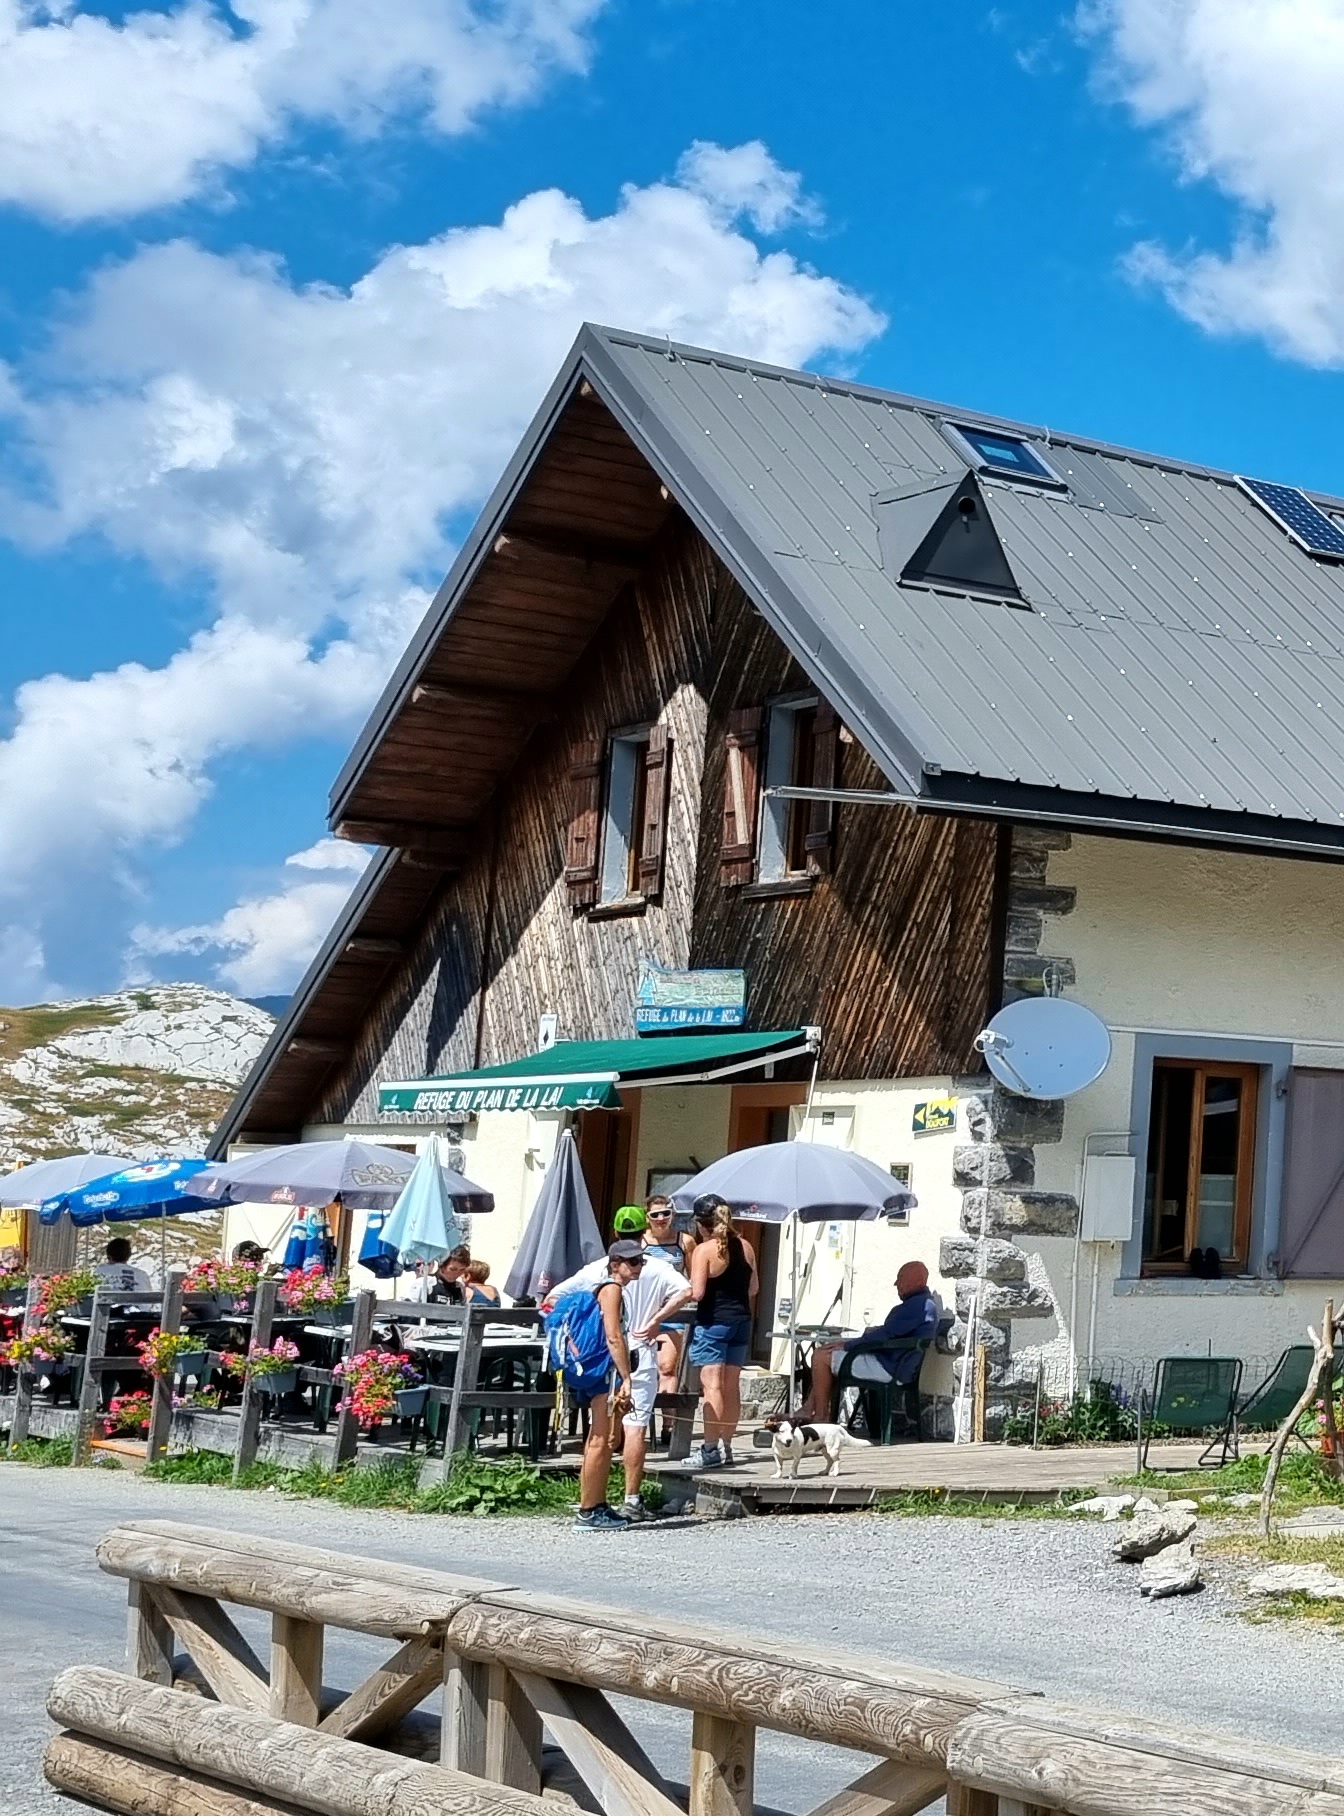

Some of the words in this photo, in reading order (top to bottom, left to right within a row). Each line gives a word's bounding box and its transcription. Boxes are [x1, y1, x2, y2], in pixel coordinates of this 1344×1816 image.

[670, 1008, 687, 1023] PLAN
[414, 1091, 455, 1110] REFUGE
[455, 1090, 471, 1109] DU
[473, 1089, 503, 1109] PLAN
[504, 1088, 521, 1107] DE
[523, 1087, 540, 1106] LA
